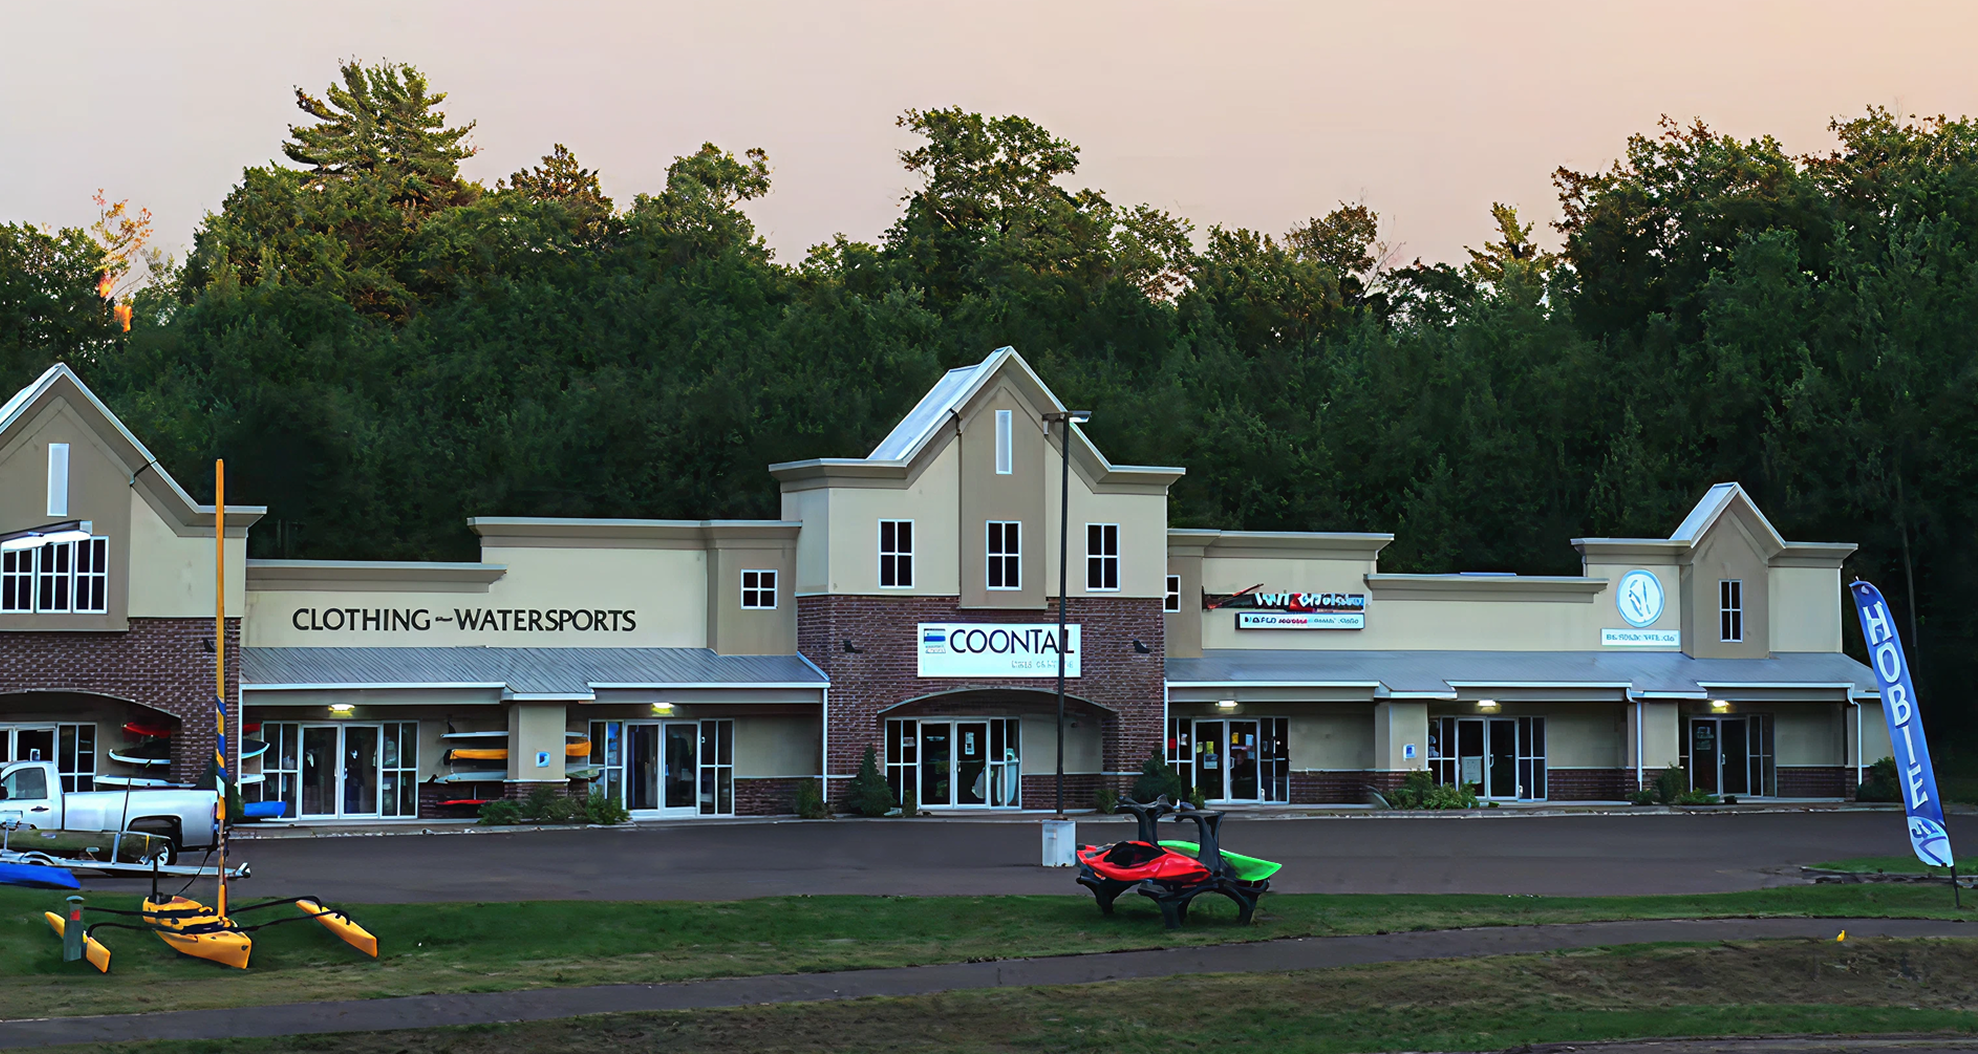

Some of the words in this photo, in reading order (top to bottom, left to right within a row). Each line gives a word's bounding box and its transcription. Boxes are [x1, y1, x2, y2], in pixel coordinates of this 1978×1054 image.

[292, 607, 431, 632] CLOTHING
[453, 607, 637, 632] WATERSPORTS
[1862, 601, 1928, 811] HOBIE
